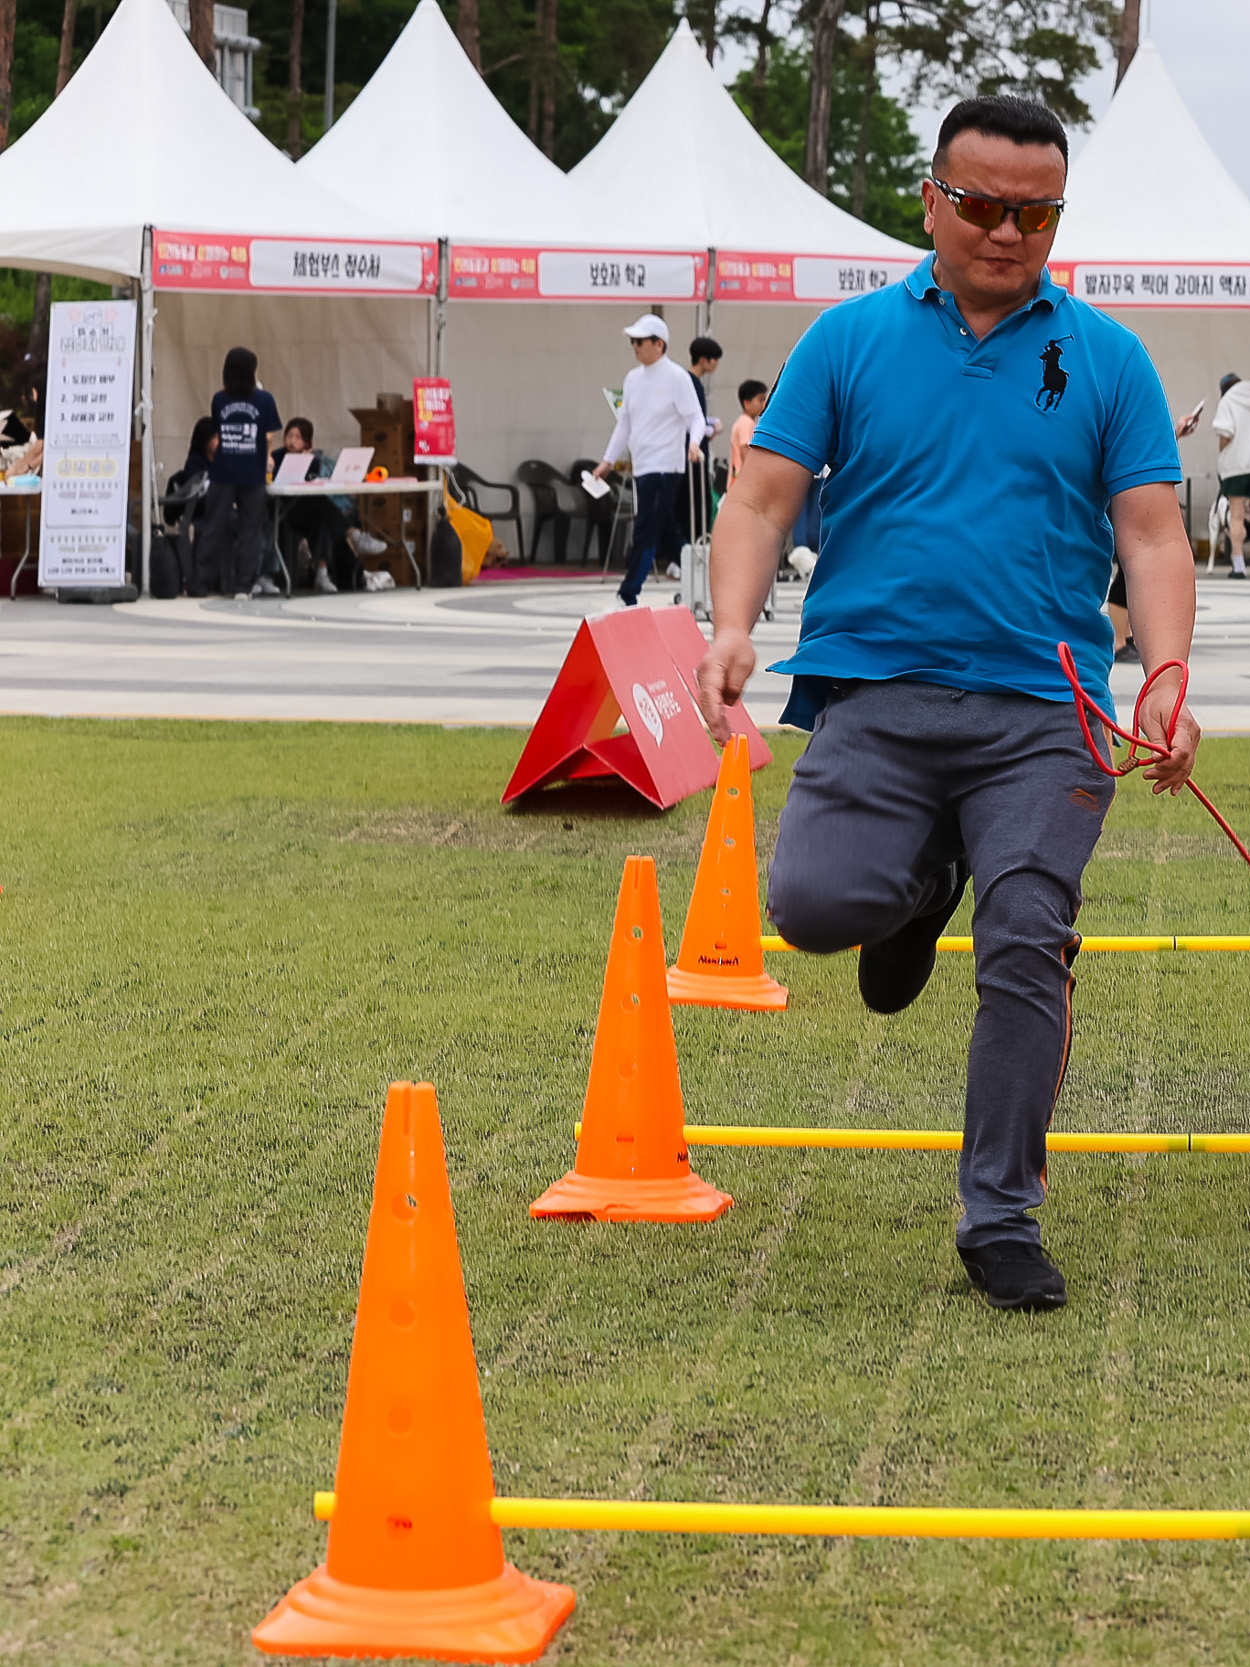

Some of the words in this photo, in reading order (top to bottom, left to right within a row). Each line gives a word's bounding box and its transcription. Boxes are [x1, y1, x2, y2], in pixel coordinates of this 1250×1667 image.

[293, 251, 340, 278] 체험부스
[344, 253, 381, 279] 접수처
[590, 262, 621, 287] 보호자
[625, 264, 646, 288] 학교
[838, 268, 866, 291] 보호자
[1085, 273, 1135, 295] 발자꾸욱
[1141, 274, 1169, 295] 찍어
[1175, 274, 1214, 295] 강아지
[1219, 275, 1247, 296] 액자
